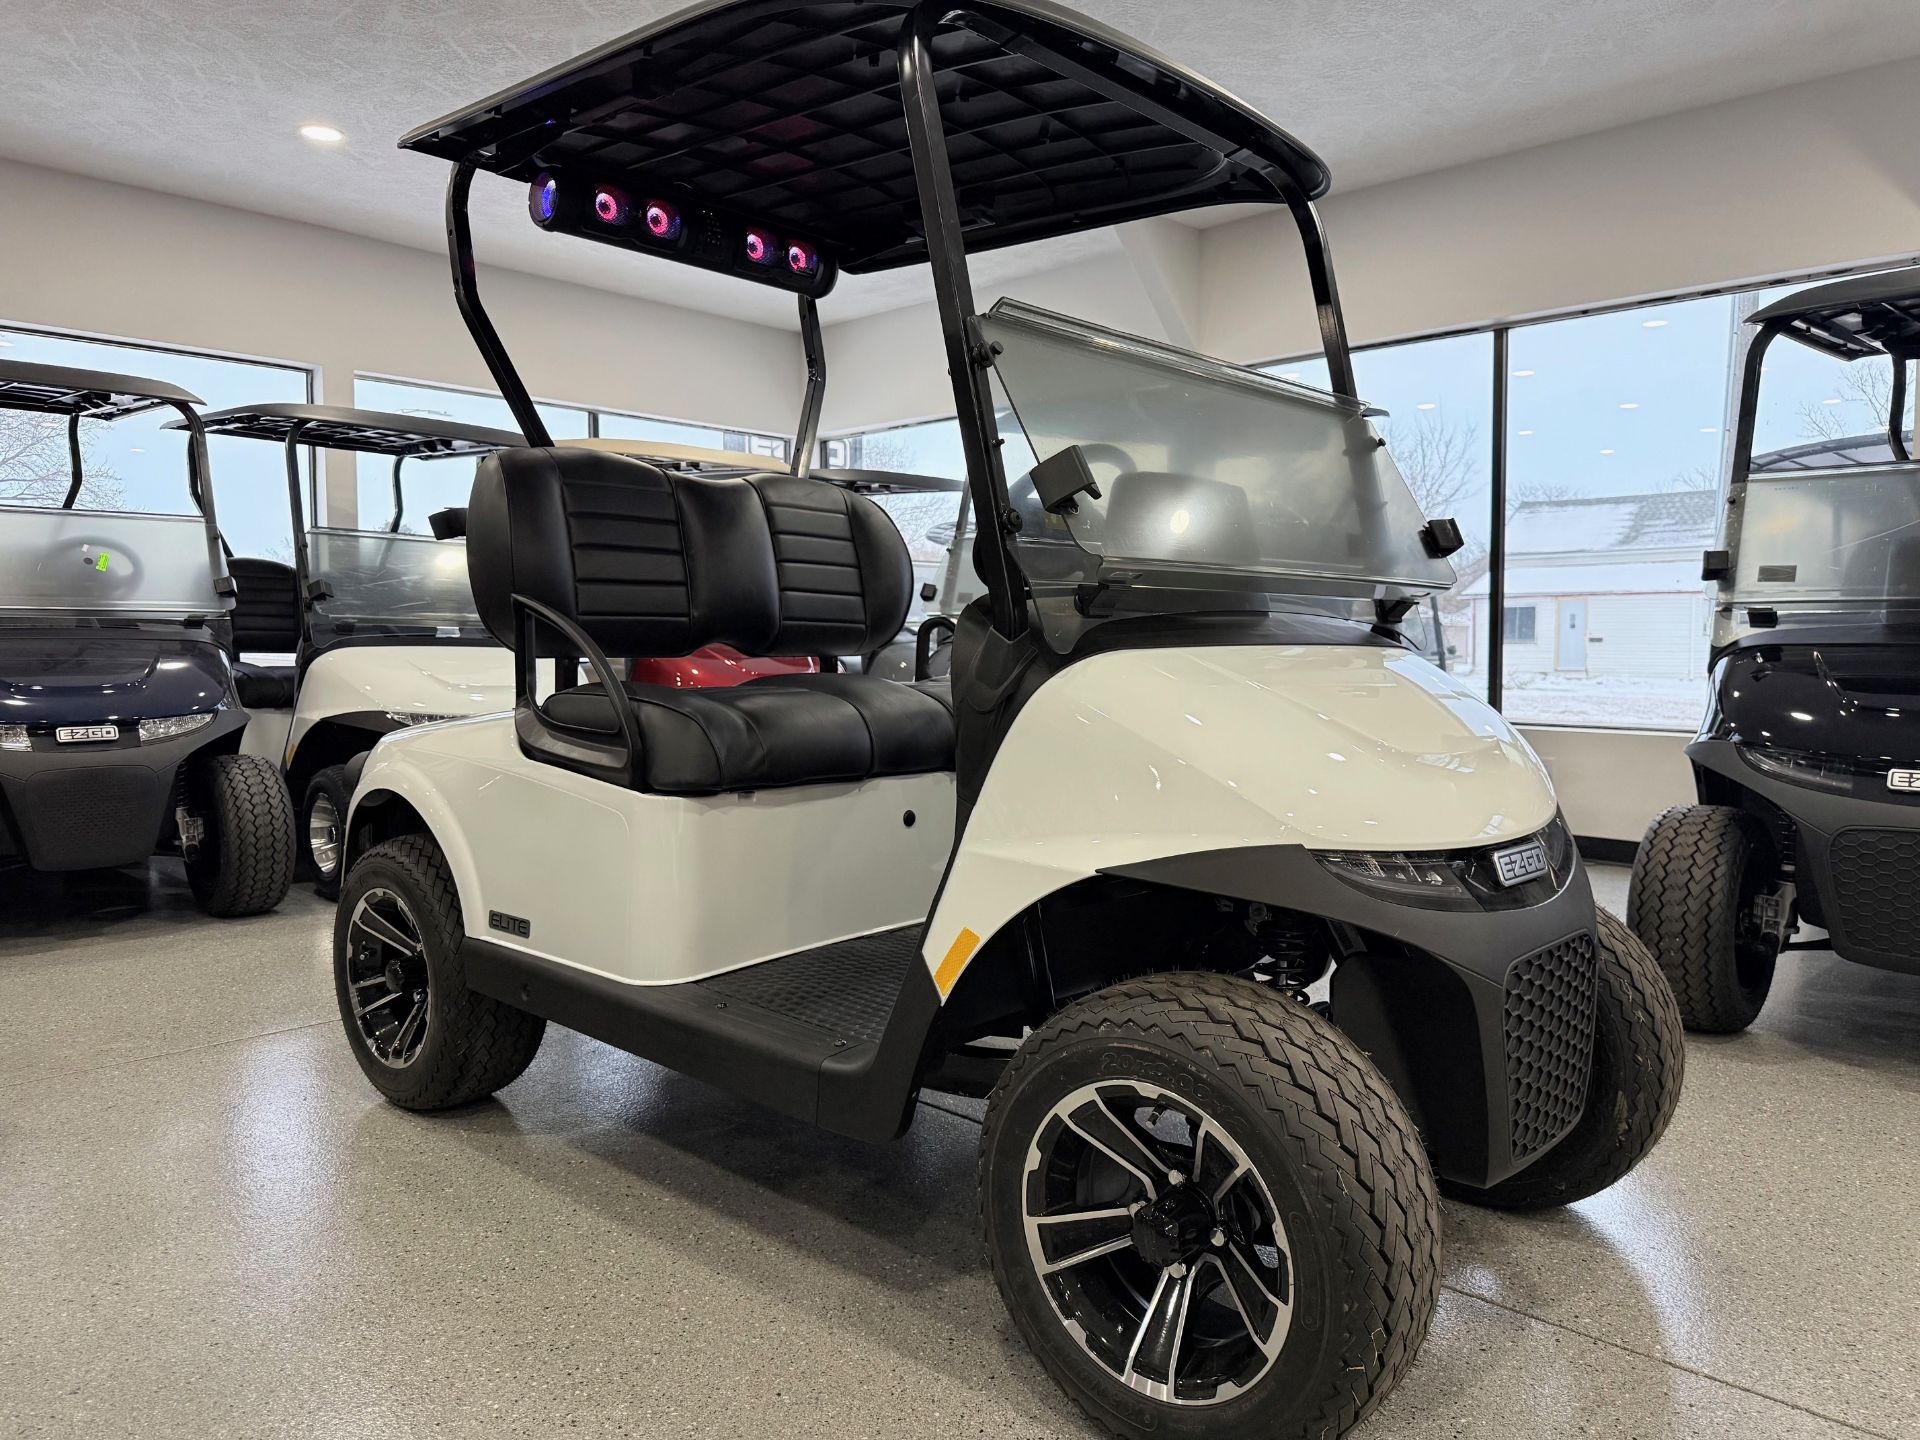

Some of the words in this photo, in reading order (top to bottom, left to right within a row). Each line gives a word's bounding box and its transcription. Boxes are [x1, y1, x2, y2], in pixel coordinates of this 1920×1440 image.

[59, 727, 116, 740] EZGO
[1498, 846, 1547, 880] EZGO
[491, 912, 528, 936] ELITE
